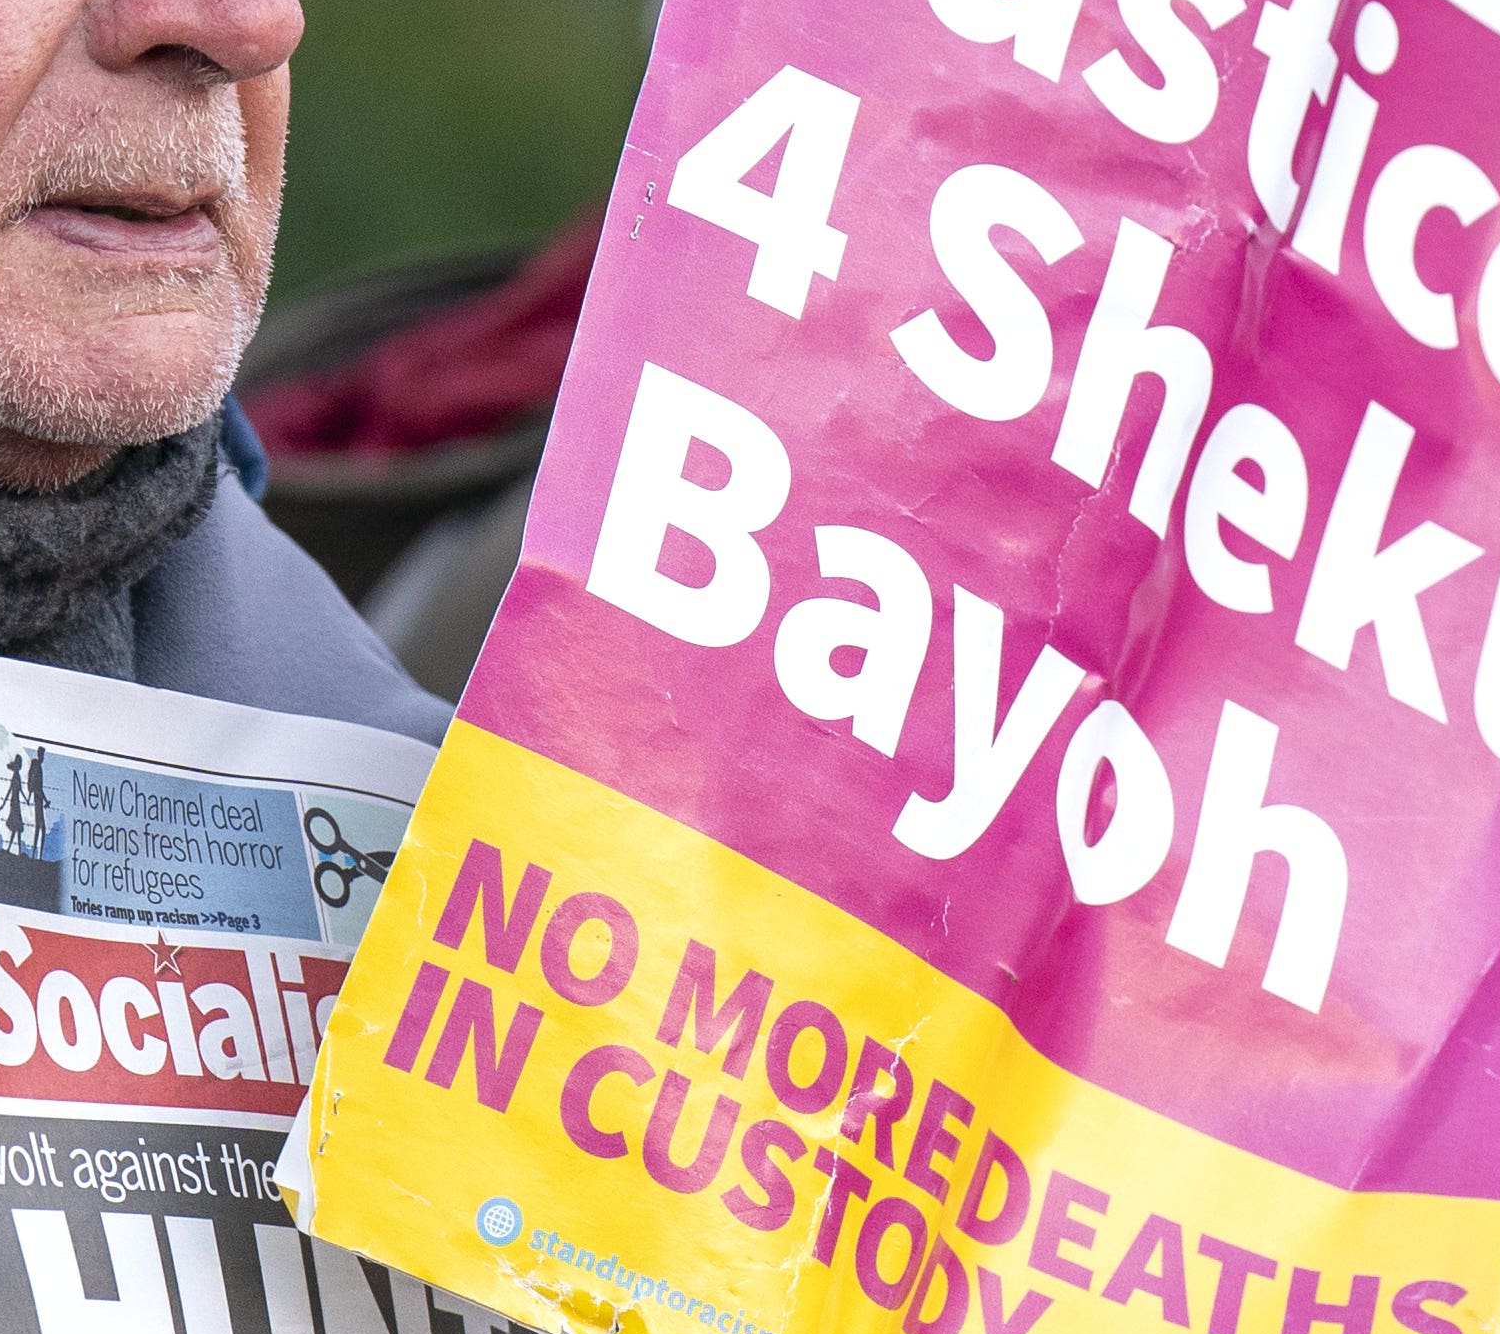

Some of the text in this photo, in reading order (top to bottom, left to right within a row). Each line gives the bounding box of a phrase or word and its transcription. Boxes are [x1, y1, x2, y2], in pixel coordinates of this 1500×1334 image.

[666, 63, 862, 320] 4
[585, 361, 1349, 1014] Bayoh
[73, 769, 263, 833] New Channel deal
[72, 818, 283, 870] means fresh horror
[72, 848, 204, 904] for refugees
[70, 895, 102, 916] Tories
[105, 905, 135, 924] ramp
[137, 909, 153, 928] up
[156, 908, 199, 925] racism
[252, 914, 261, 930] 3
[383, 969, 545, 1113] IN
[434, 838, 640, 1007] NO
[656, 939, 976, 1199] MORE
[69, 1138, 217, 1203] against
[221, 1143, 283, 1203] the
